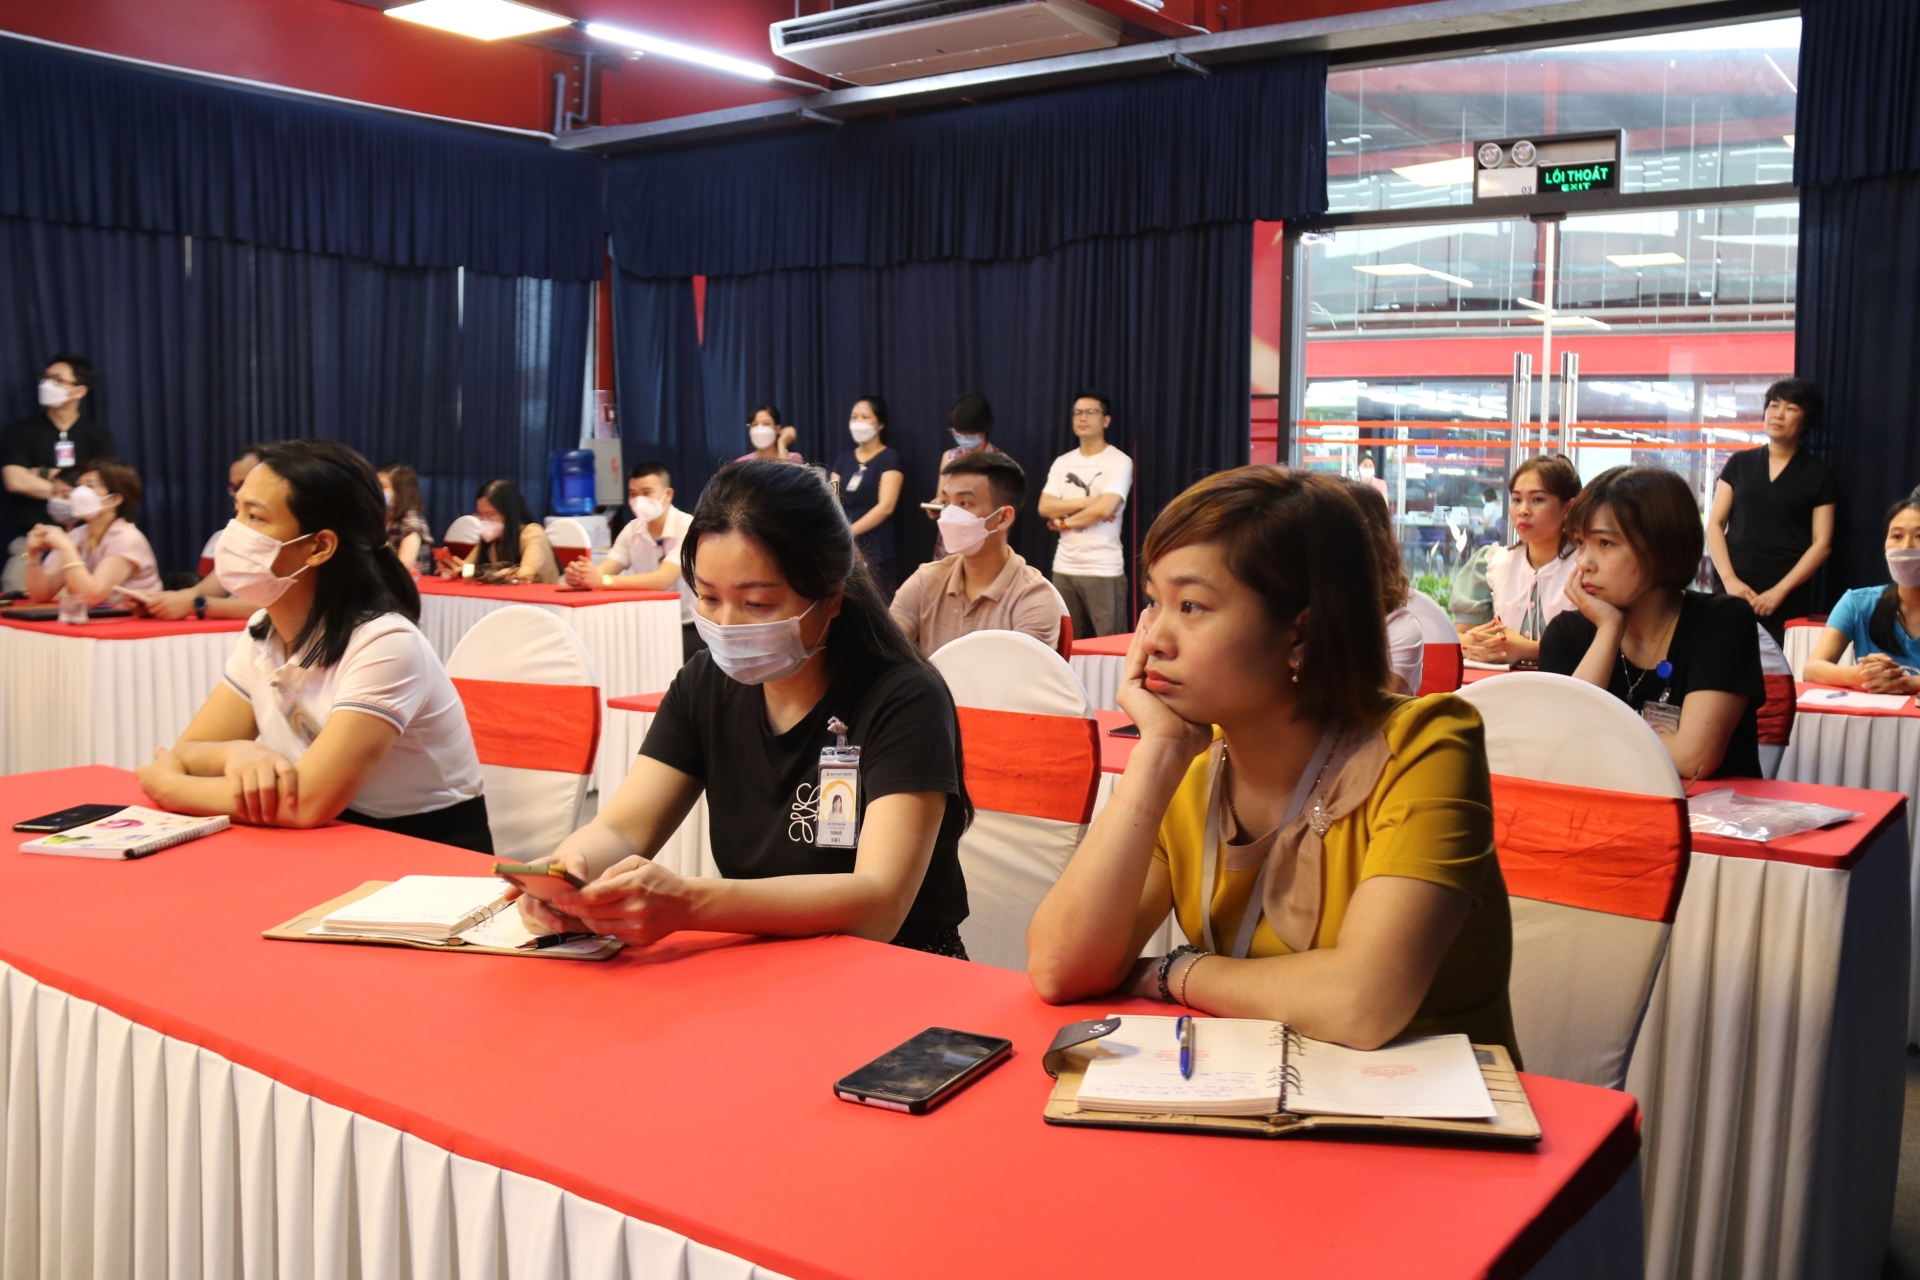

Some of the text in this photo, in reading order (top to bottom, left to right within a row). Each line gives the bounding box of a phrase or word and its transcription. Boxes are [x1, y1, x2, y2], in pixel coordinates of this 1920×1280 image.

[1567, 165, 1609, 182] THOÁT
[1521, 186, 1533, 194] 03
[1561, 182, 1591, 192] EXIT
